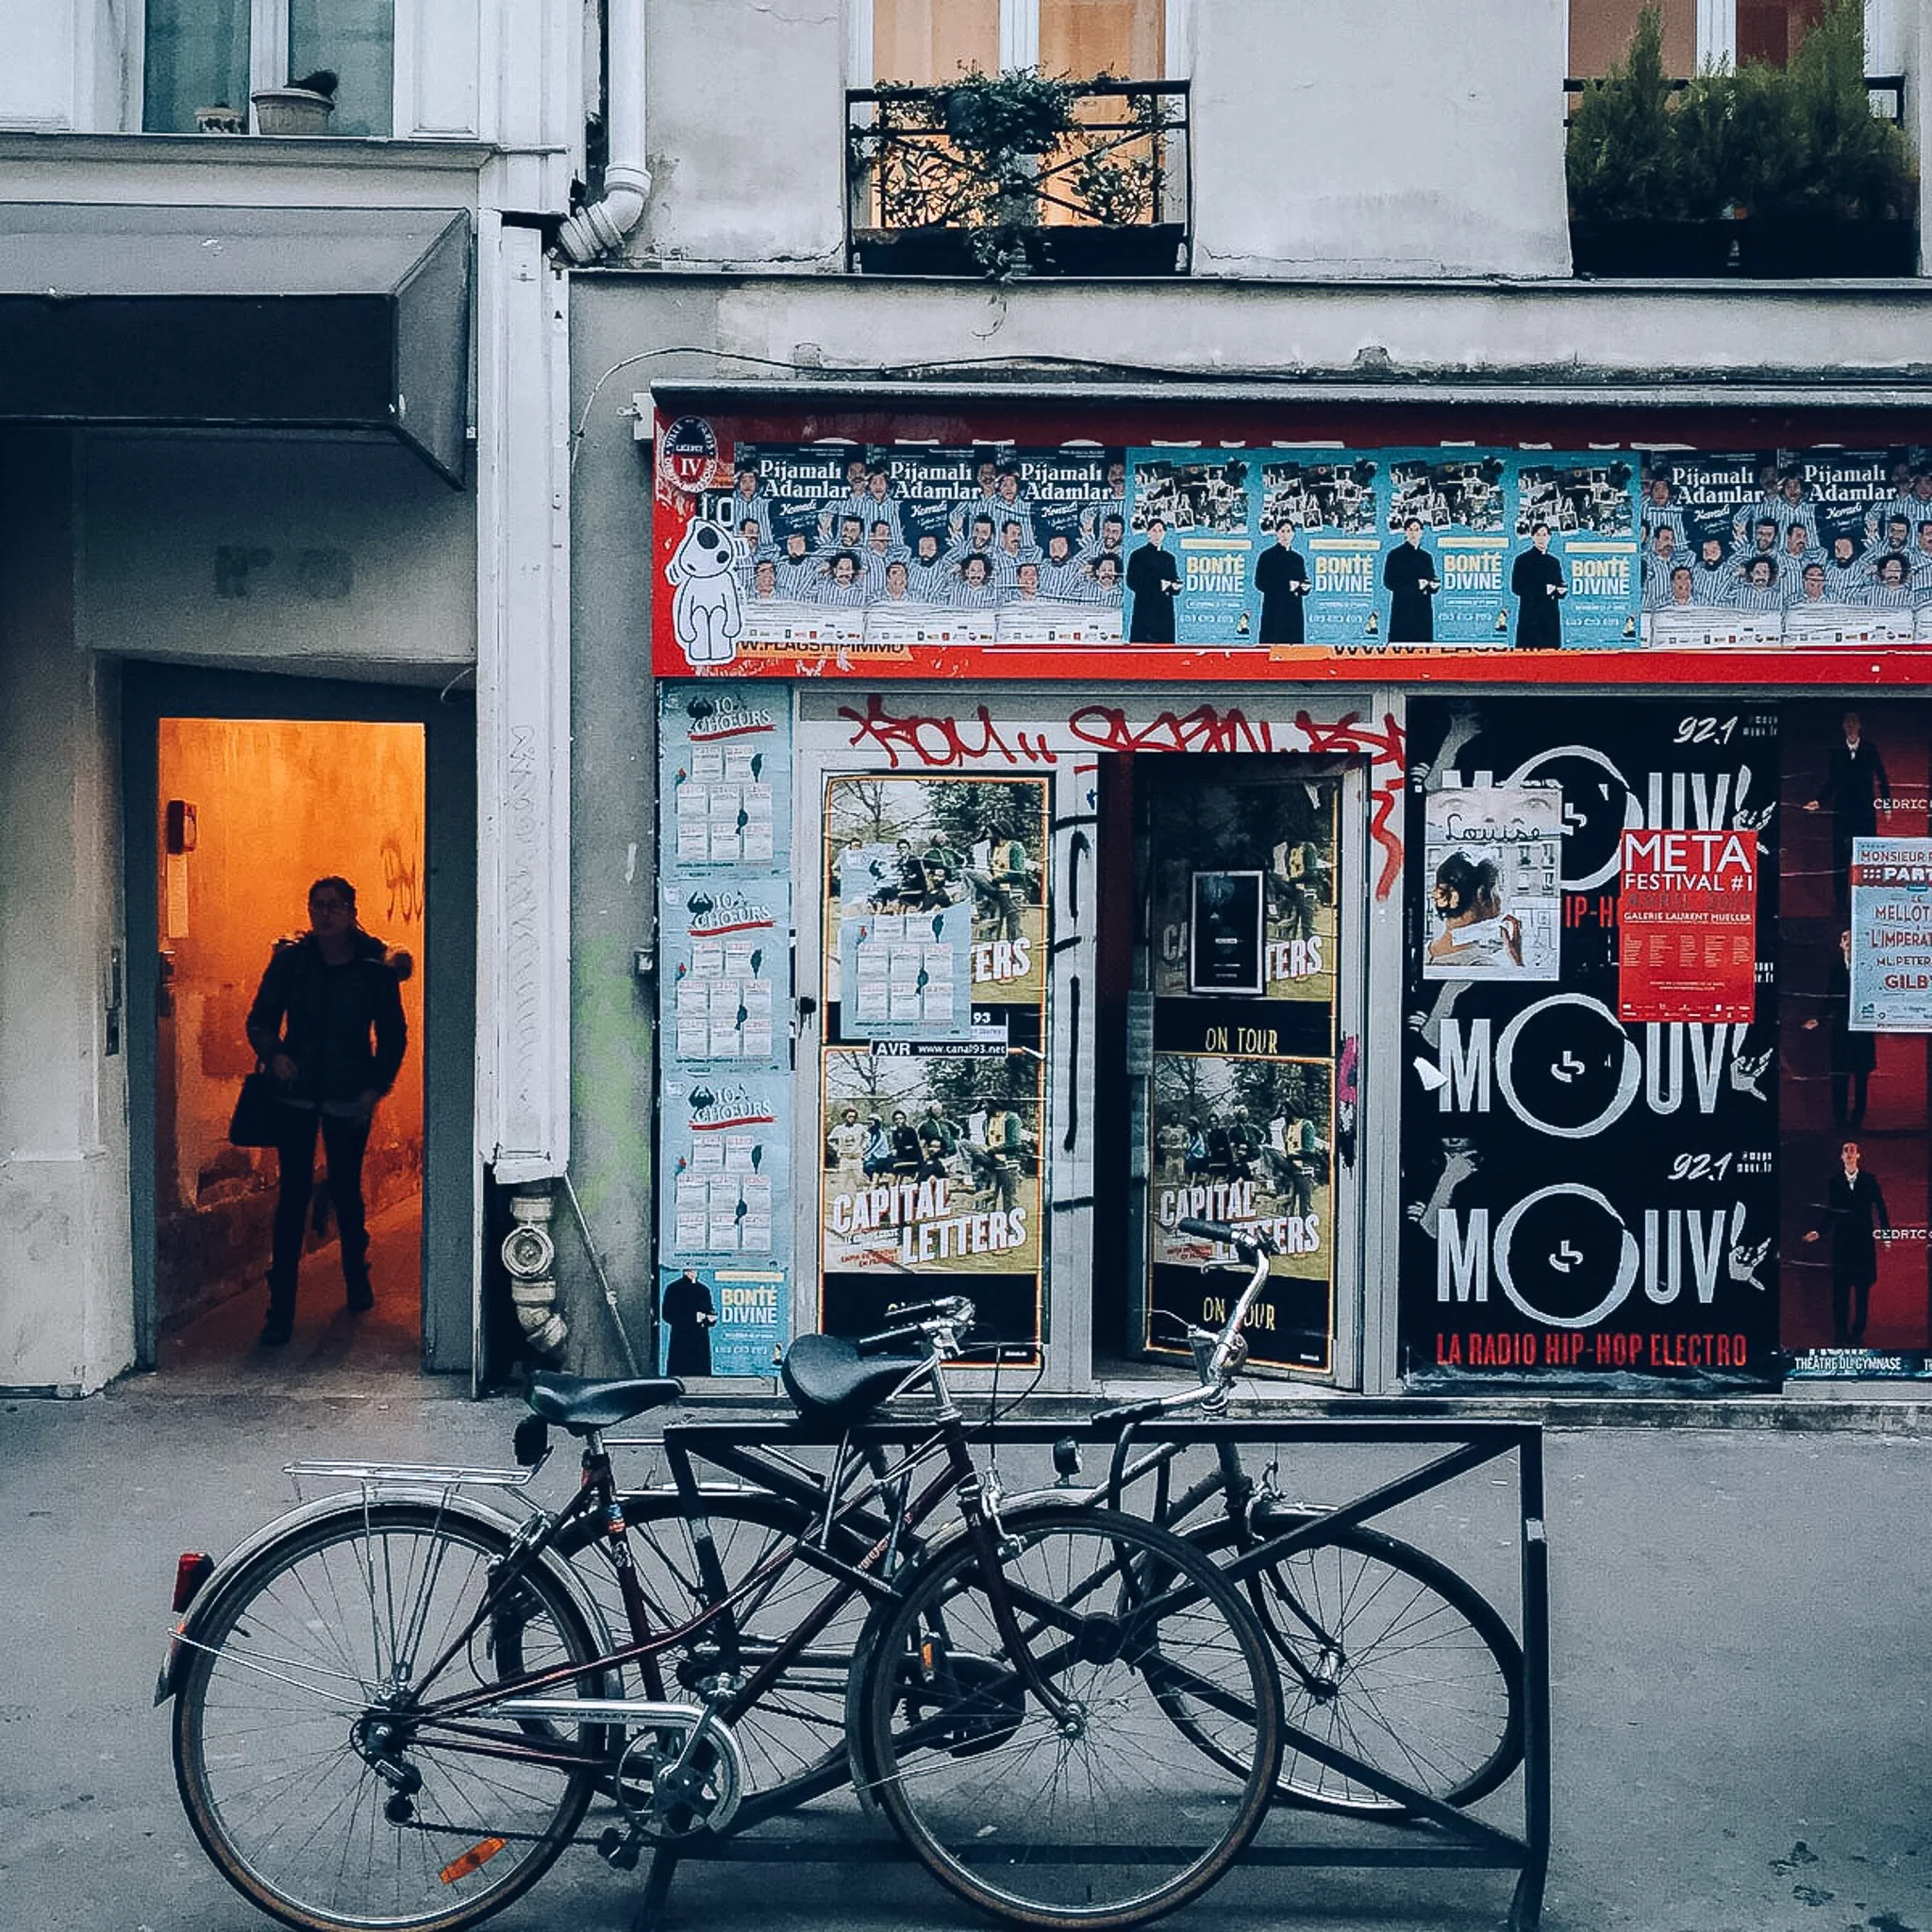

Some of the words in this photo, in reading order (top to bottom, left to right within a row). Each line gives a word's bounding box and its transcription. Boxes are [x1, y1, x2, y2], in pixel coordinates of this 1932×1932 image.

[681, 458, 702, 475] IV
[762, 479, 852, 499] Adamlar
[893, 480, 983, 500] Adamlar
[1024, 481, 1114, 500] Adamlar
[1675, 486, 1765, 505] Adamlar
[1808, 483, 1897, 502] Adamlar
[1186, 554, 1245, 575] BONTÉ
[1315, 554, 1374, 575] BONTÉ
[1443, 552, 1503, 573] BONTÉ
[1571, 557, 1630, 577] BONTÉ
[1186, 575, 1244, 593] DIVINE
[1315, 575, 1373, 593] DIVINE
[1443, 573, 1503, 591] DIVINE
[1571, 577, 1630, 595] DIVINE
[1674, 715, 1739, 744] 92.1
[1624, 833, 1753, 874] META
[1861, 851, 1924, 862] MONSIEUR
[1624, 874, 1724, 891] FESTIVAL
[1624, 911, 1662, 921] GALERIE
[1665, 912, 1708, 921] LAURENT
[1265, 935, 1322, 982] TERS
[876, 1042, 911, 1056] AVR
[1206, 1027, 1228, 1052] ON
[1238, 1028, 1278, 1054] TOUR
[1668, 1151, 1733, 1181] 92.1
[832, 1177, 951, 1232] CAPITAL
[1159, 1181, 1257, 1226] CAPITAL
[902, 1207, 1027, 1264] LETTERS
[721, 1285, 778, 1307] BONTÉ
[721, 1307, 778, 1324] DIVINE
[1203, 1297, 1225, 1324] ON
[1239, 1302, 1276, 1331] OUR
[1436, 1333, 1462, 1365] LA
[1469, 1333, 1538, 1365] RADIO
[1544, 1333, 1643, 1365] HIP-HOP
[1650, 1333, 1748, 1366] ELECTRO
[1856, 1357, 1902, 1371] GYMNASE
